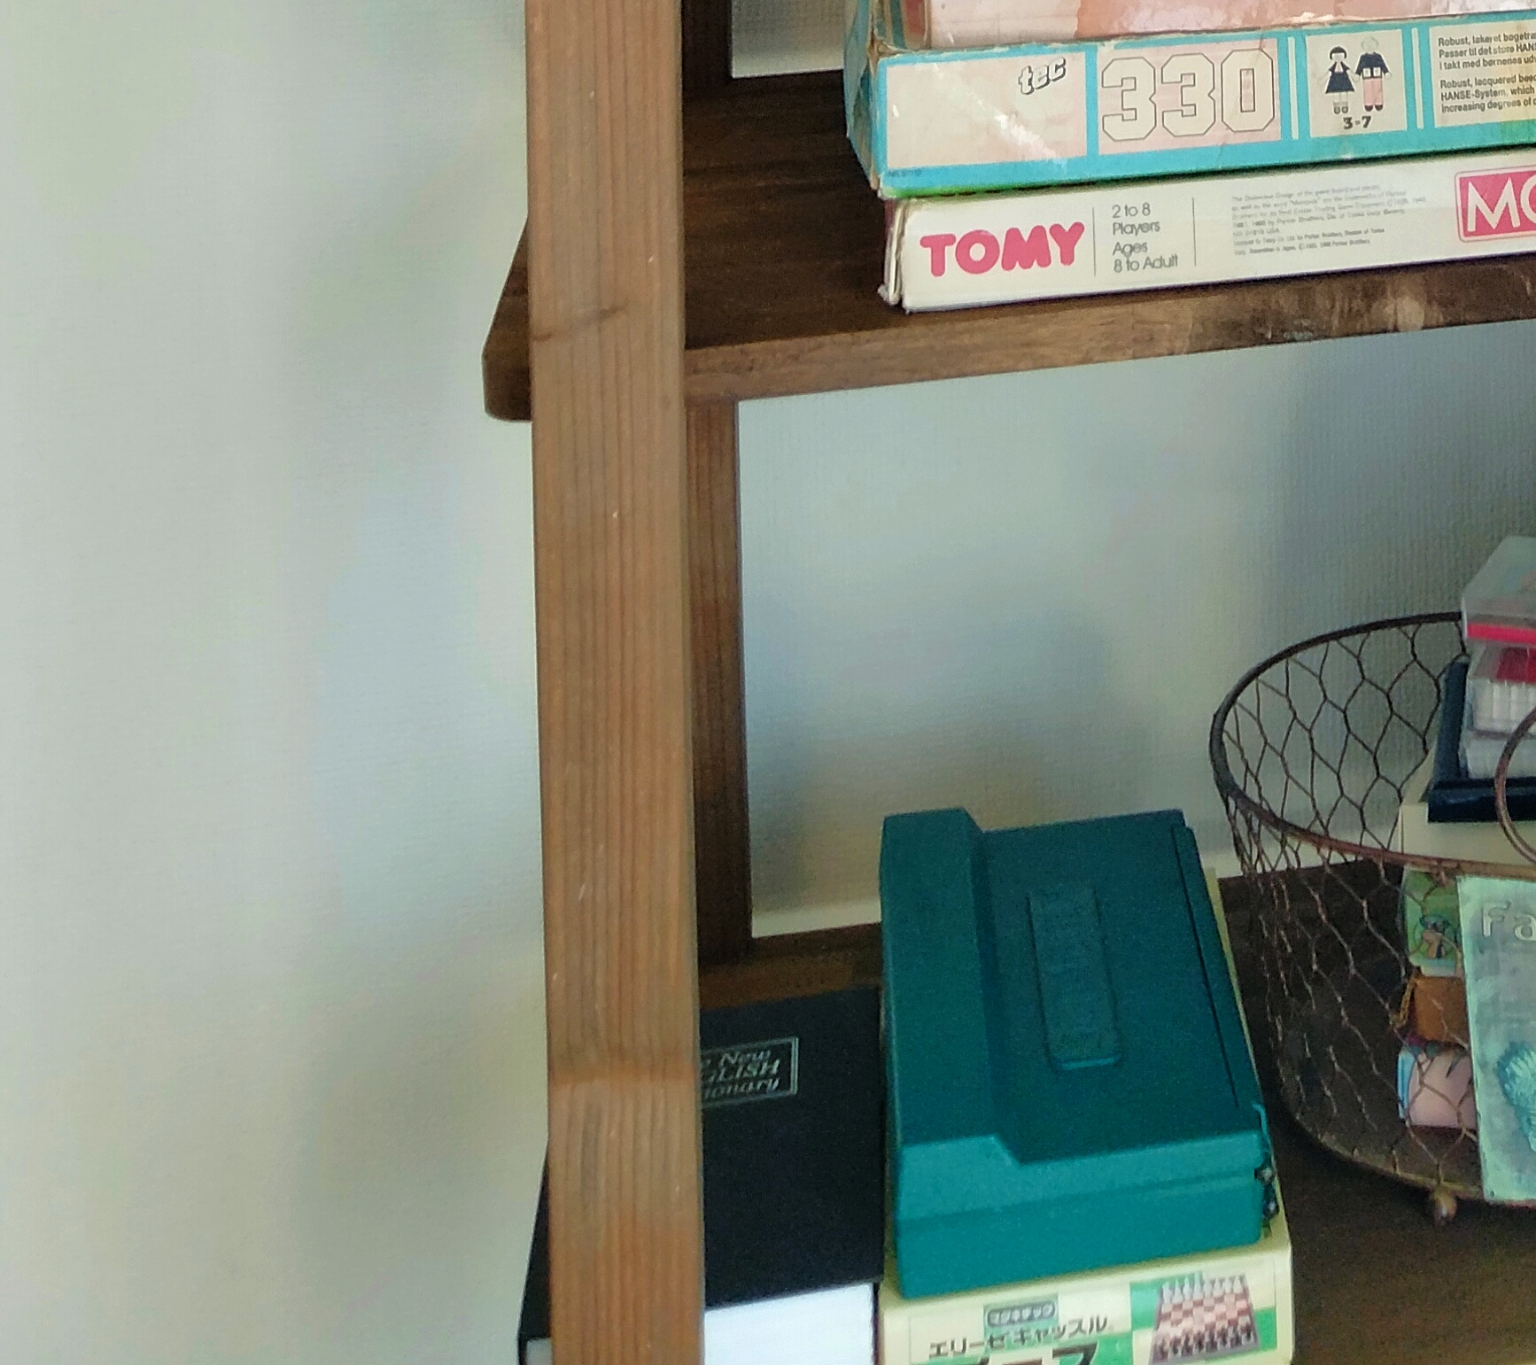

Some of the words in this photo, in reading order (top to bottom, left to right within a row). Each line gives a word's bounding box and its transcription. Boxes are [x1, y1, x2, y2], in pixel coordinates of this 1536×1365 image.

[1017, 57, 1067, 96] tec
[1474, 74, 1517, 88] lacquered
[1100, 48, 1277, 143] 330
[1510, 83, 1535, 96] which
[1111, 203, 1121, 219] 2
[1123, 203, 1140, 218] to
[1141, 201, 1152, 216] 8
[1111, 218, 1162, 238] Players
[919, 220, 1086, 278] TOMY
[1112, 238, 1149, 258] Ages
[1112, 259, 1123, 274] 8
[1124, 258, 1140, 272] to
[1141, 253, 1179, 271] Adult
[1012, 1315, 1109, 1347] キャッスル
